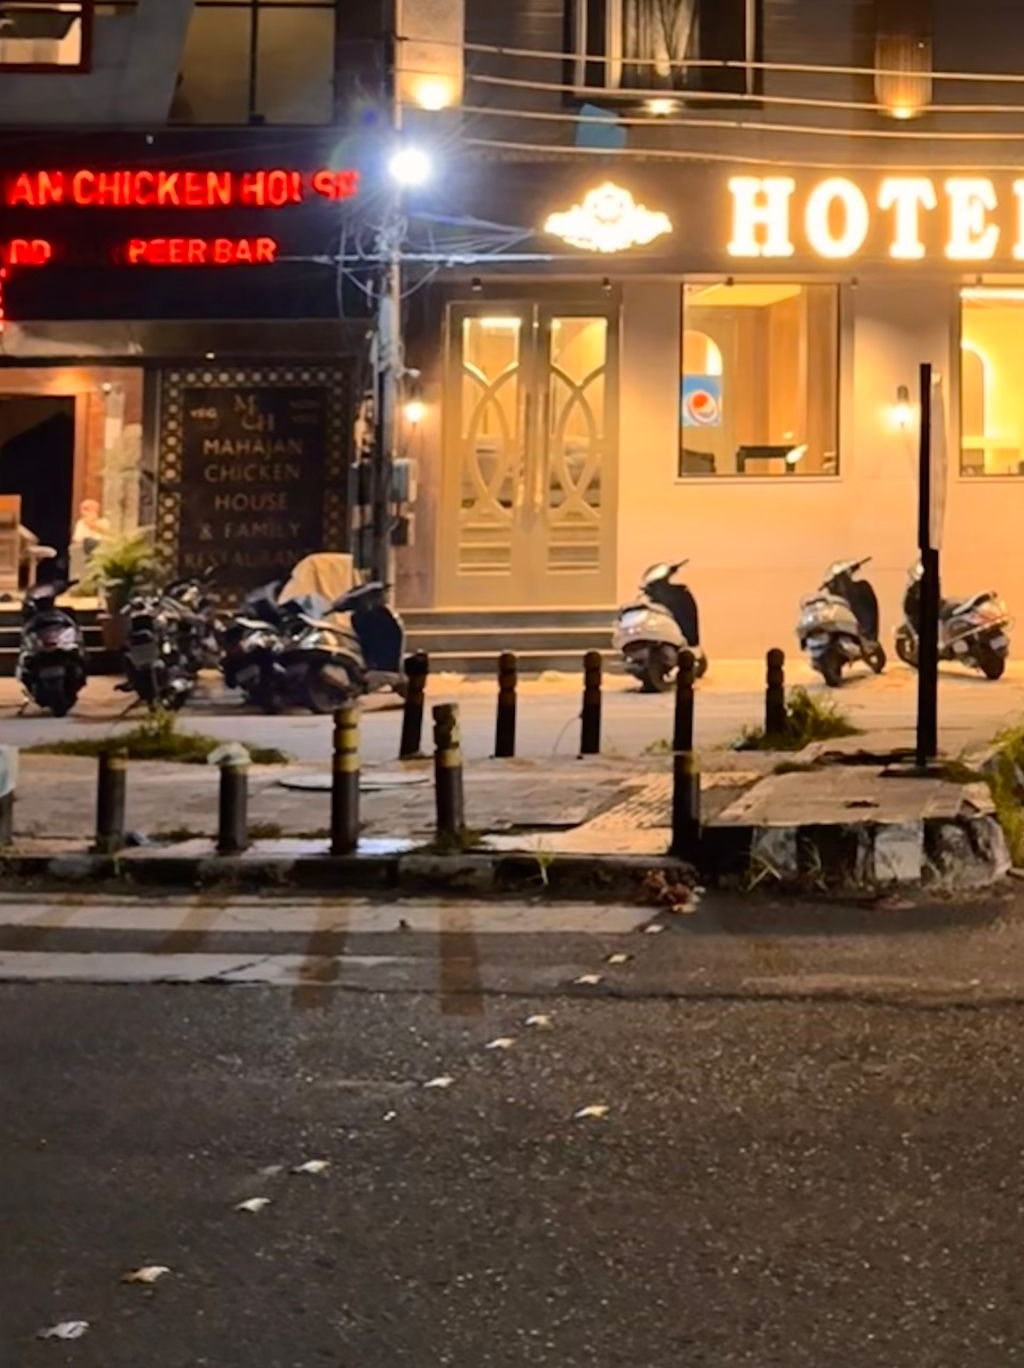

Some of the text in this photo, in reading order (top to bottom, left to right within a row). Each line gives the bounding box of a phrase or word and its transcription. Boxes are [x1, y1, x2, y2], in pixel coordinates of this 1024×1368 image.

[73, 169, 232, 207] CHICKEN
[213, 237, 278, 264] BAR
[202, 438, 304, 460] MAHAJAN
[203, 464, 301, 482] CHICKEN
[214, 492, 288, 511] HOUSE
[223, 522, 302, 539] FAMILY
